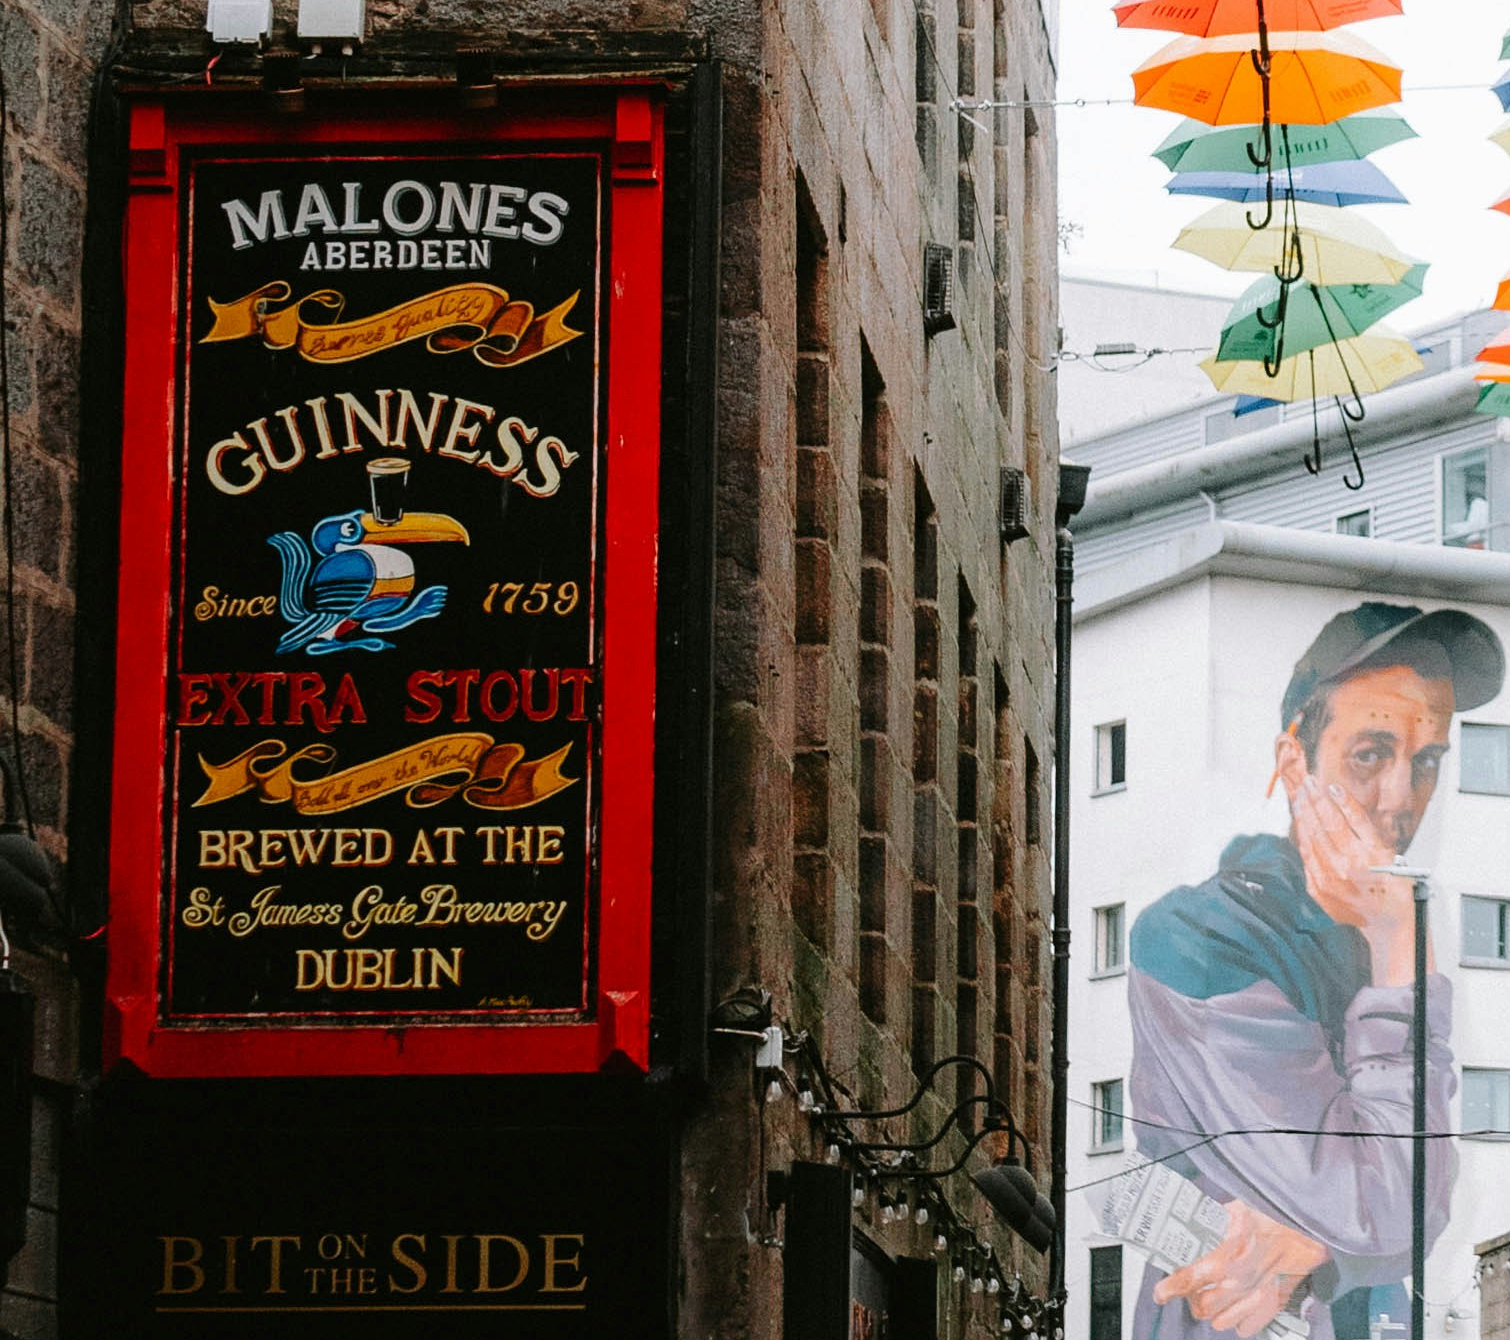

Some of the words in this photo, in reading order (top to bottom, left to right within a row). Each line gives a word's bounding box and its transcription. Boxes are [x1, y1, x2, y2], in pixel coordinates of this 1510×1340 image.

[221, 180, 570, 250] MALONES
[300, 239, 491, 271] ABERDEEN
[206, 388, 579, 497] GUINNESS
[194, 586, 276, 621] Since
[483, 581, 579, 616] 1759
[177, 672, 367, 733] EXTRA
[405, 668, 593, 724] STOUT
[199, 828, 394, 874] BREWED
[407, 826, 464, 865] AT
[475, 826, 565, 865] THE
[182, 886, 226, 927] St
[342, 885, 418, 940] Gate
[415, 883, 567, 941] Brewery
[295, 948, 464, 992] DUBLIN
[156, 1235, 301, 1295] BIT
[317, 1233, 369, 1260] ON
[387, 1233, 588, 1294] SIDE
[303, 1268, 378, 1295] THE
